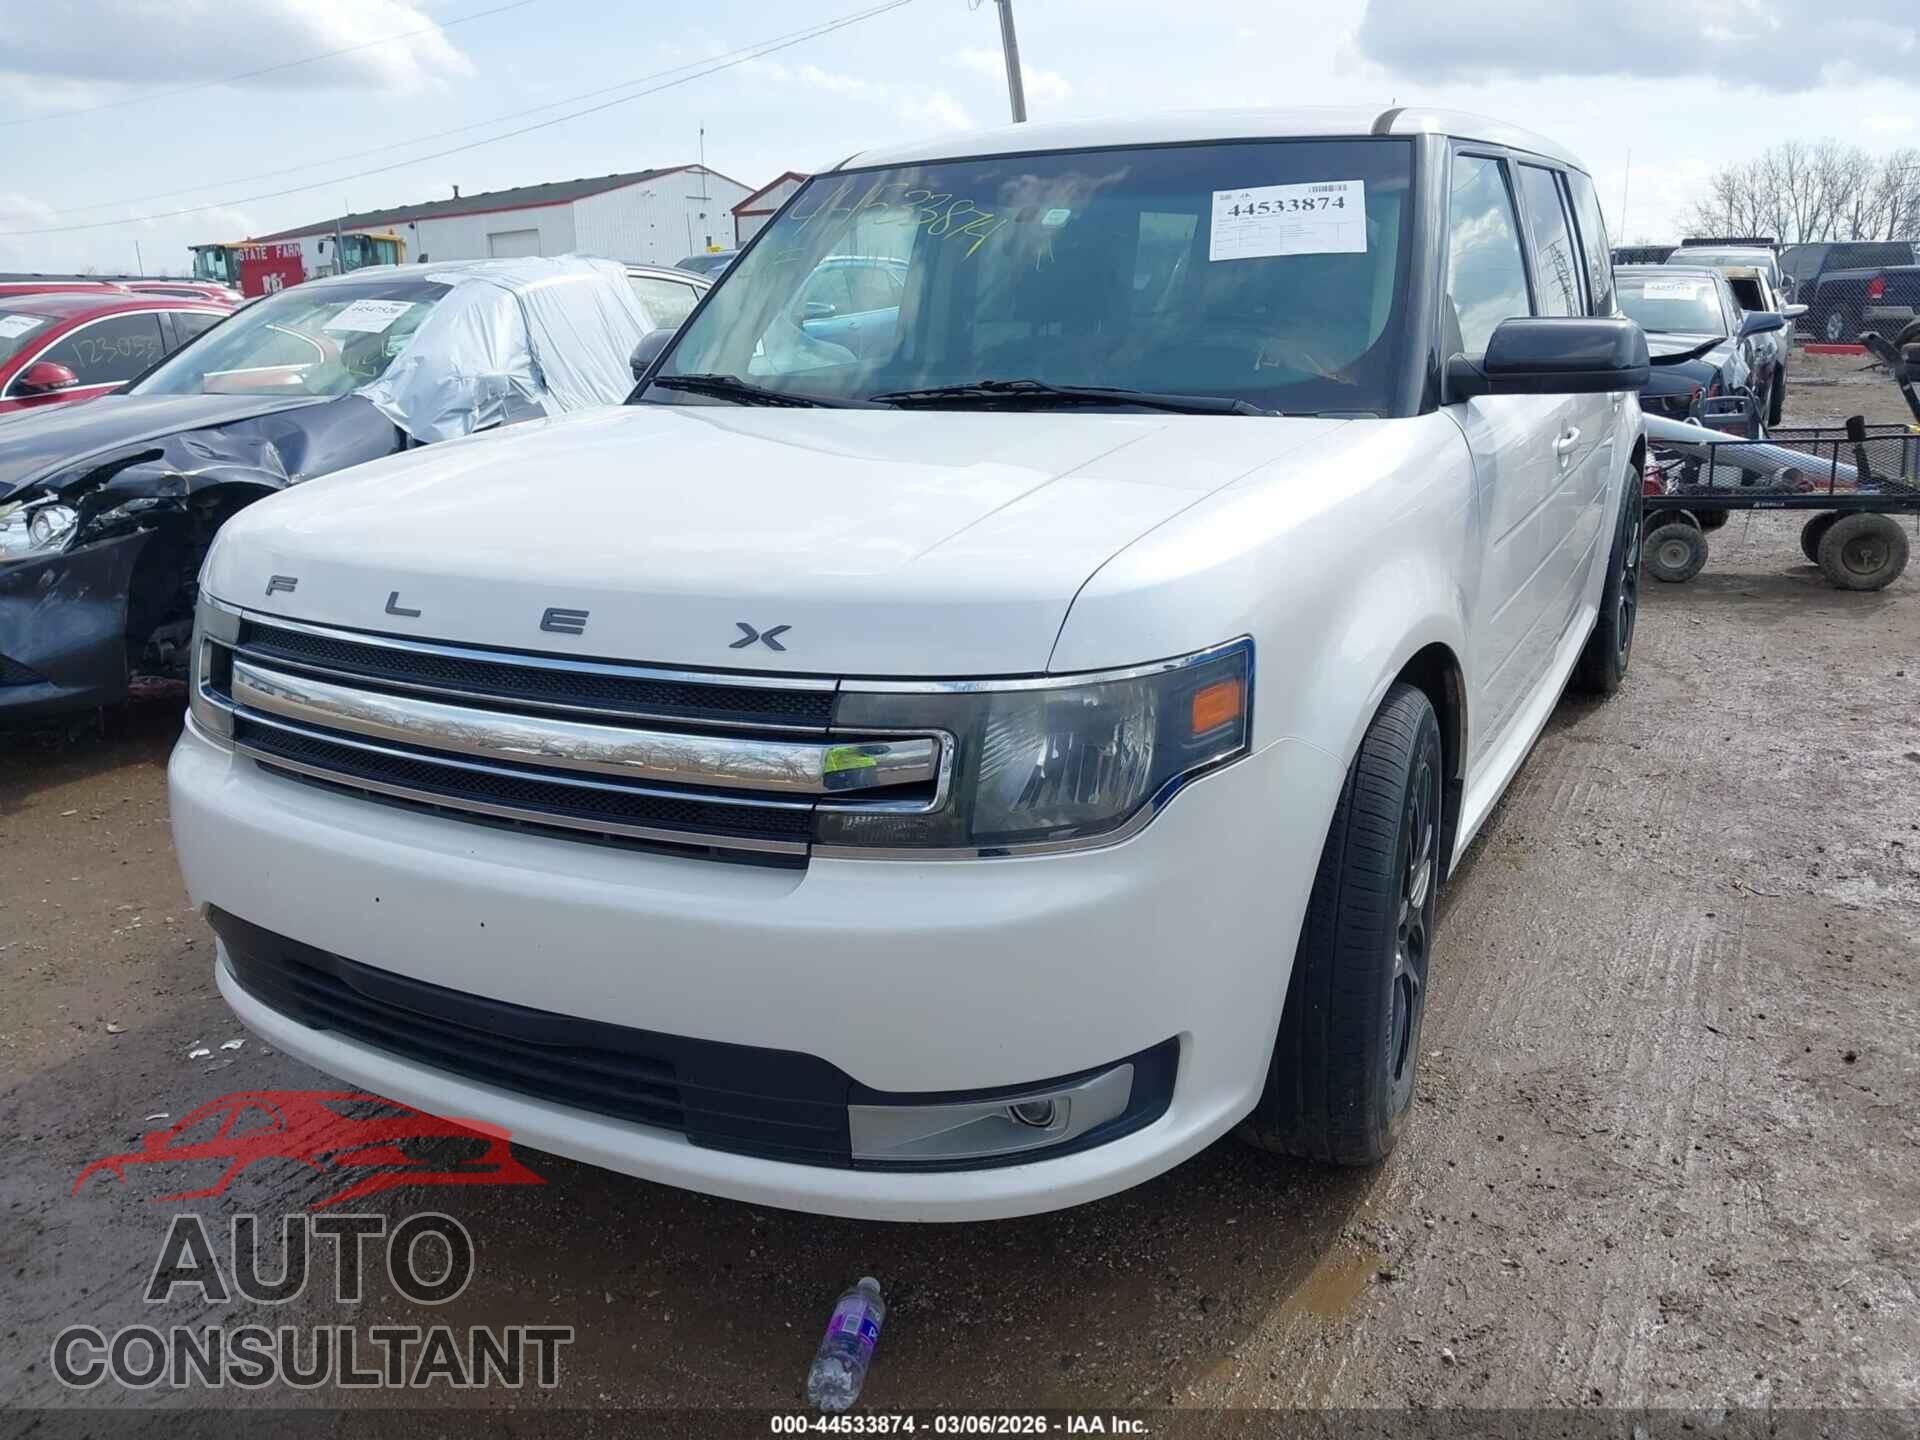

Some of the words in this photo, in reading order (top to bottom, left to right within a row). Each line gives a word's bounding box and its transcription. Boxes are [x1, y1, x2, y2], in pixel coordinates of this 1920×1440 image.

[1227, 196, 1345, 217] 44533874
[240, 247, 267, 261] STATE
[266, 575, 792, 651] FLEX
